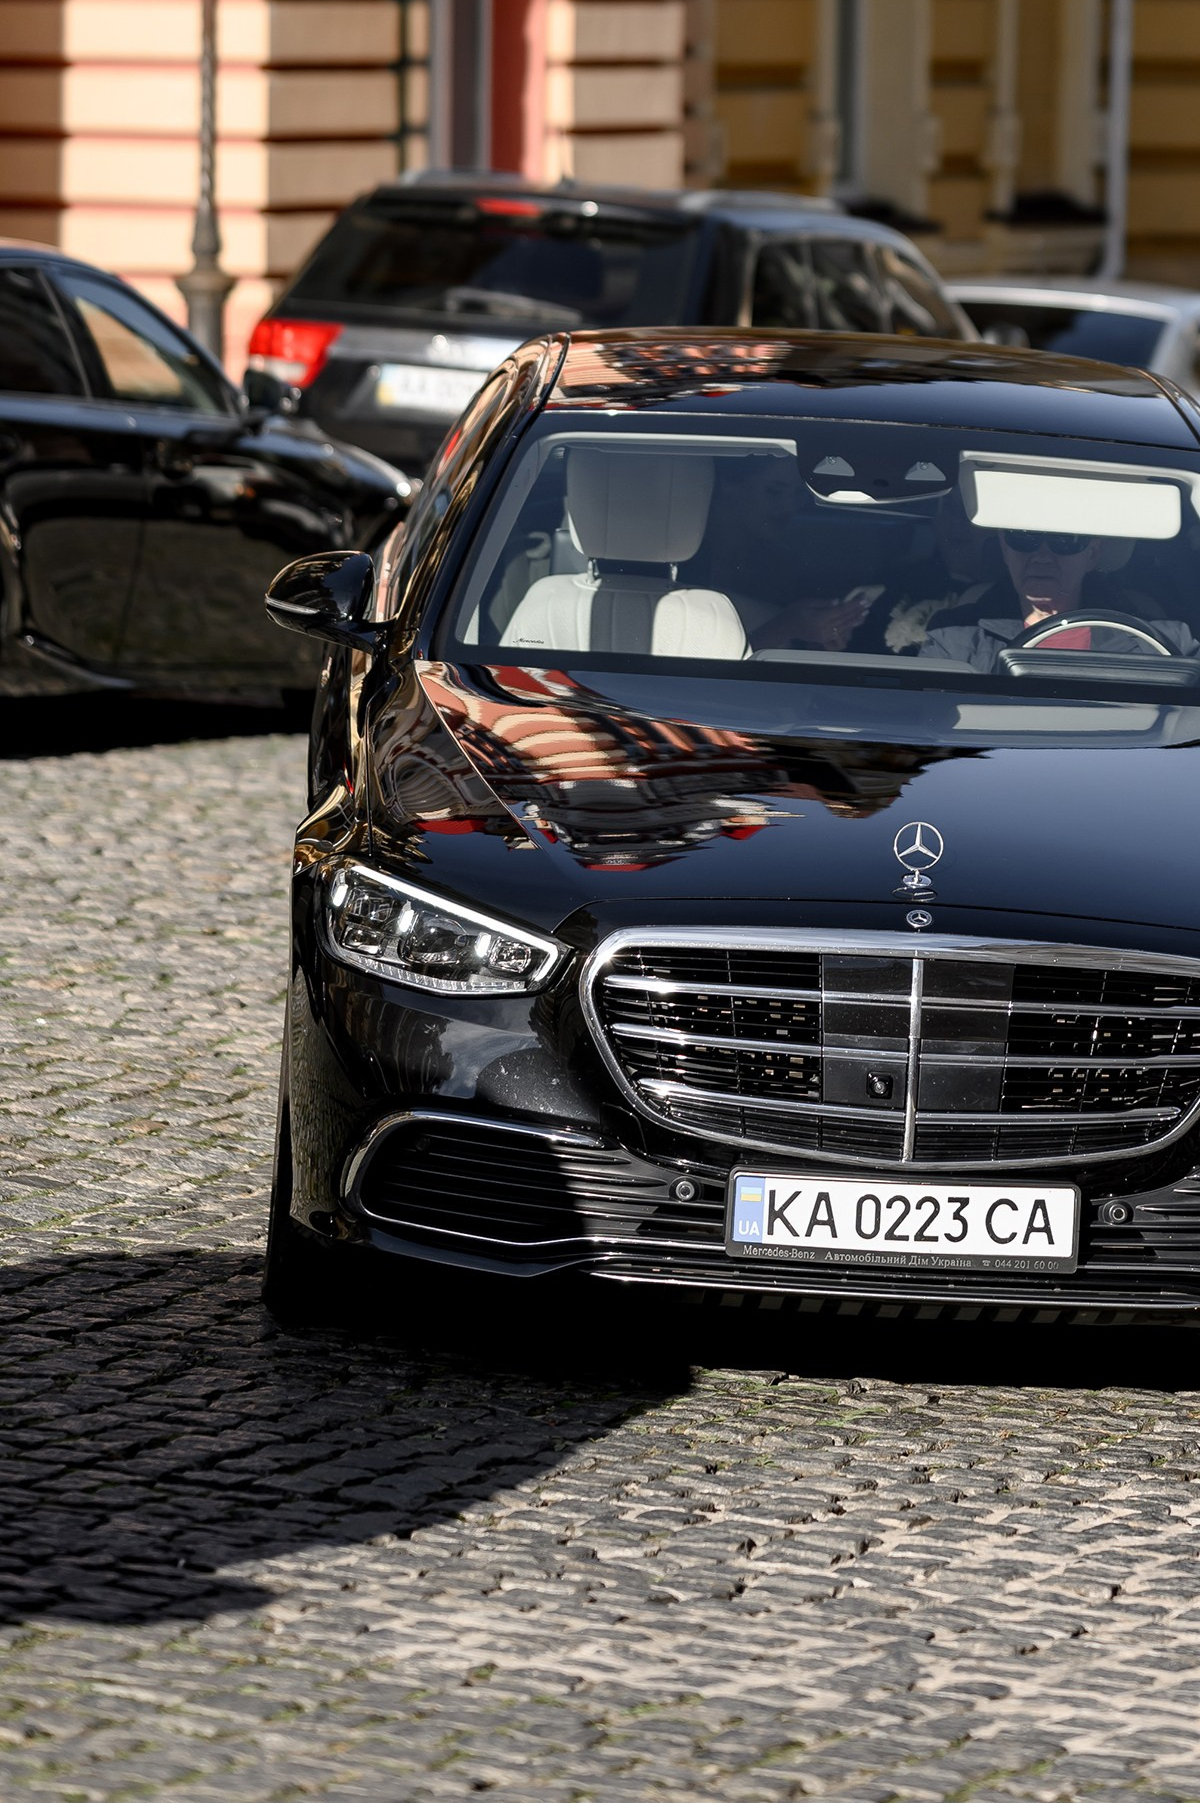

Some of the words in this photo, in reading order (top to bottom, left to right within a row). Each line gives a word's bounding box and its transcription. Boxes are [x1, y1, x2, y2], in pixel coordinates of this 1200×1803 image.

[767, 1189, 838, 1238] KA
[855, 1194, 970, 1243] 0223
[985, 1198, 1055, 1245] CA
[738, 1220, 760, 1236] UA
[742, 1245, 816, 1259] Mercedes-Benz
[824, 1251, 907, 1265] Автомобільний
[908, 1255, 929, 1266] Дім
[931, 1256, 972, 1269] Україна
[994, 1258, 1012, 1269] 044
[1013, 1259, 1030, 1269] 201
